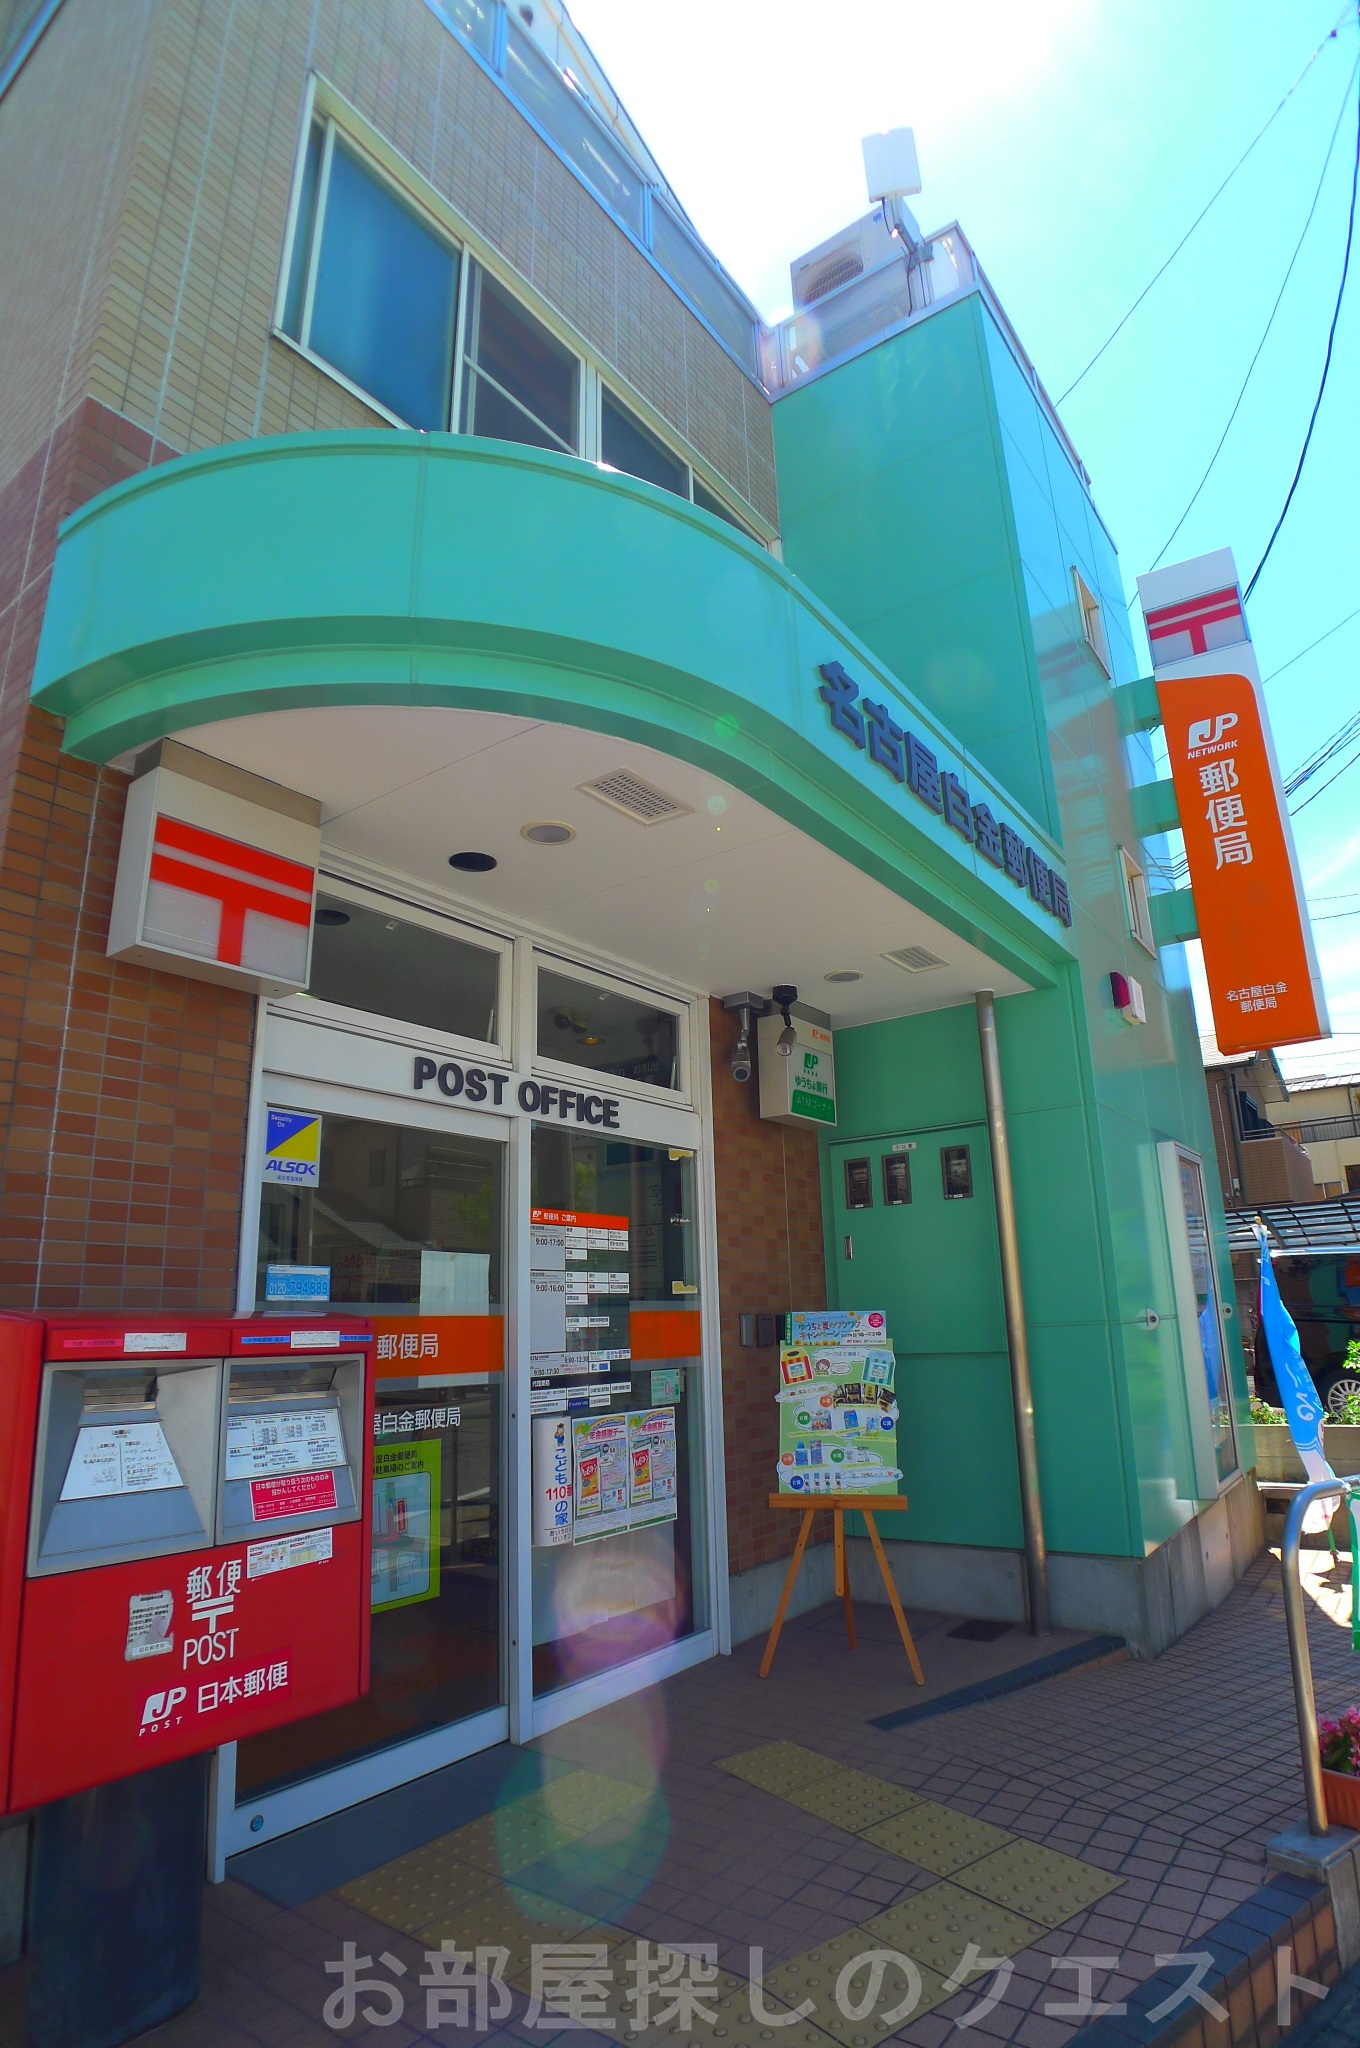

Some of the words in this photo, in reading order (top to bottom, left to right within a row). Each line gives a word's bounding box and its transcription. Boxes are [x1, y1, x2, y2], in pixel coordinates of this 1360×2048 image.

[1187, 739, 1238, 760] NETWORK
[817, 660, 1072, 927] 名古屋白金郵便局
[1198, 758, 1254, 871] 郵便局
[1226, 981, 1288, 1001] 名古屋白金
[1240, 999, 1278, 1013] 郵便局
[413, 1056, 509, 1106] POST
[518, 1080, 620, 1129] OFFICE
[795, 1075, 828, 1095] ゆうちょ銀行
[271, 1114, 293, 1123] Security
[265, 1159, 317, 1176] ALSOK
[561, 1213, 577, 1223] ご案内
[535, 1237, 565, 1247] 9:00-17:00
[535, 1284, 565, 1293] 9:00-16:00
[799, 1331, 840, 1340] キャンペーン
[376, 1333, 439, 1360] 郵便局
[533, 1367, 560, 1376] 9:00-17:30
[374, 1449, 417, 1464] 屋白金郵便局
[186, 1559, 243, 1604] 郵便
[182, 1628, 240, 1670] POST
[197, 1660, 288, 1714] 日本郵便
[138, 1716, 183, 1737] POST
